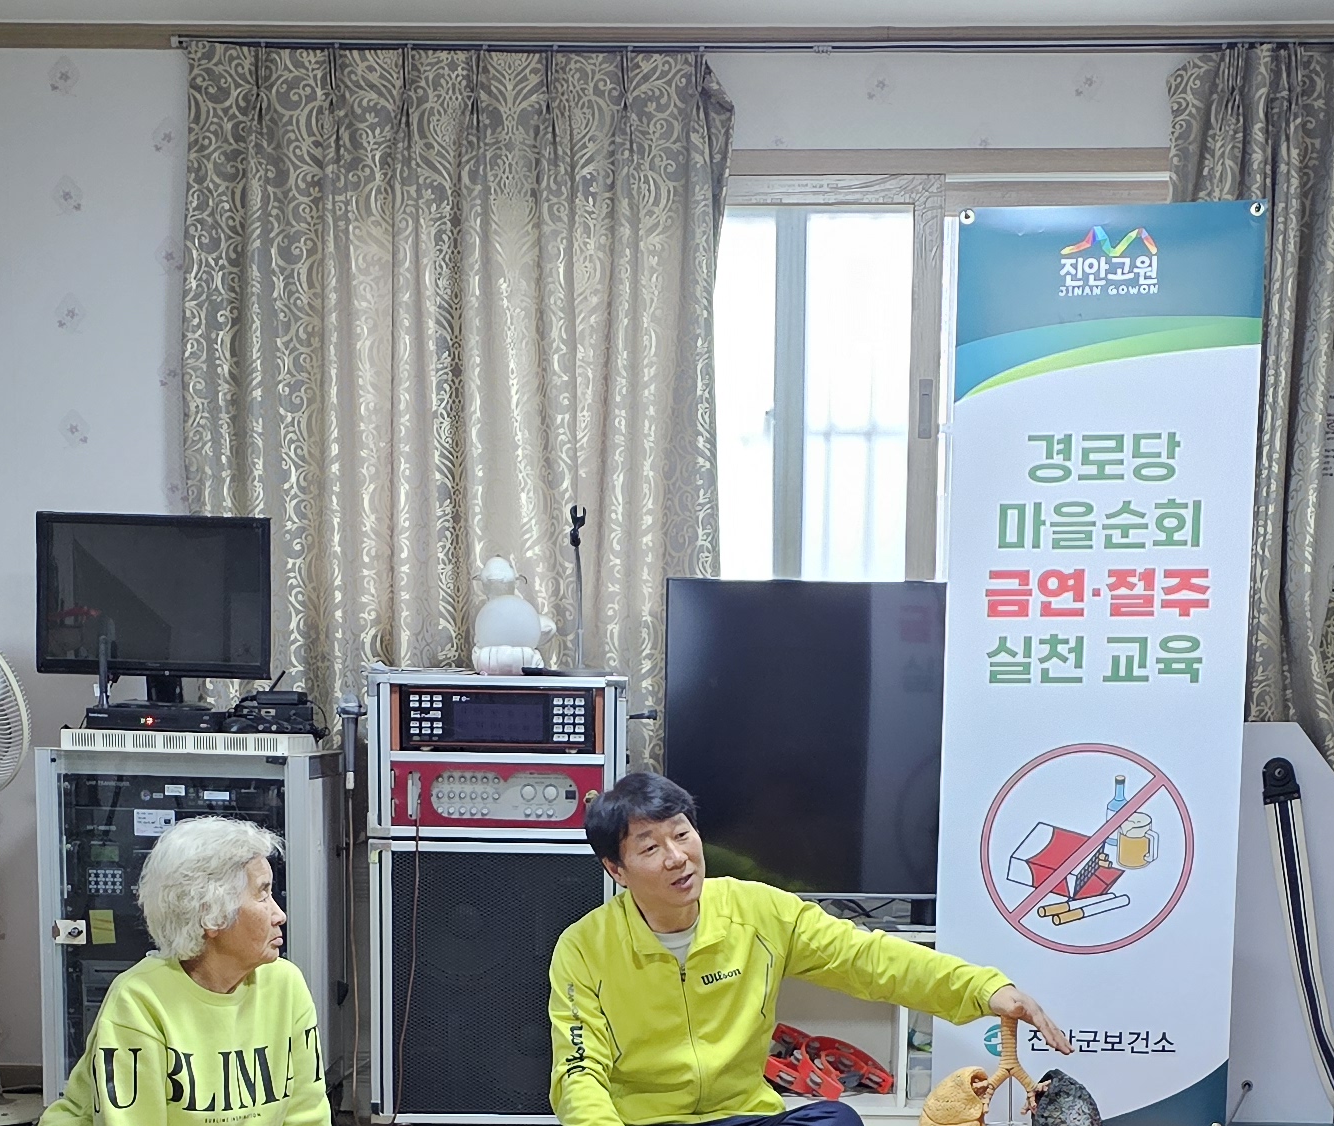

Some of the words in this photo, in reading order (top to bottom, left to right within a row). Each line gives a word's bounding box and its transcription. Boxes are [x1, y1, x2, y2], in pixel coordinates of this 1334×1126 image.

[1059, 286, 1101, 296] JINAN
[1108, 285, 1158, 295] GOWON
[1060, 256, 1157, 286] 진안고원
[1027, 432, 1181, 483] 경로당
[998, 499, 1202, 550] 마을순회
[985, 567, 1211, 618] 금연·절주
[986, 634, 1084, 684] 실천
[1102, 634, 1203, 683] 교육
[701, 969, 741, 985] Wilson
